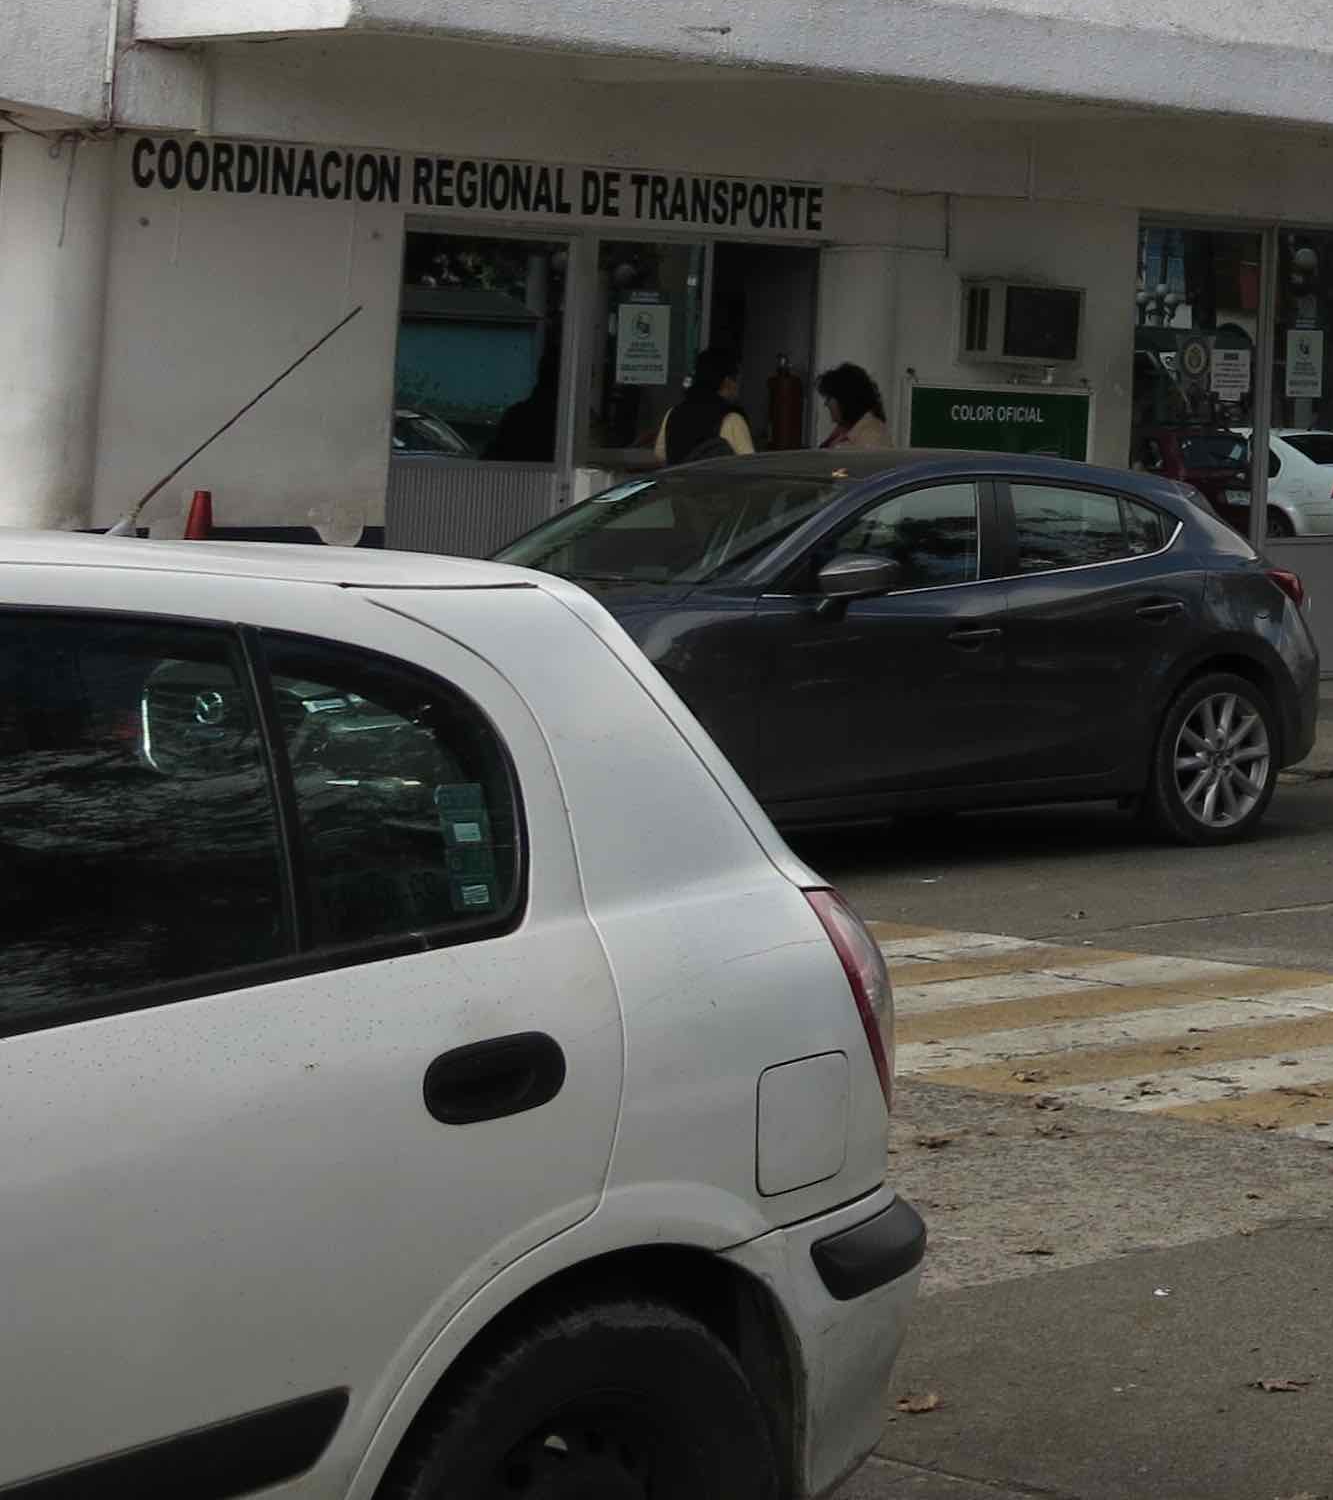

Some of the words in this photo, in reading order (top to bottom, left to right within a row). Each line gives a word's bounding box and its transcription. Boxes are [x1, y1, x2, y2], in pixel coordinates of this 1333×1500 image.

[132, 138, 401, 203] COORDINACION
[412, 157, 572, 215] REGIONAL
[581, 170, 622, 218] DE
[630, 174, 824, 231] TRANSPORTE
[951, 403, 993, 423] COLOR
[996, 405, 1044, 425] OFICIAL
